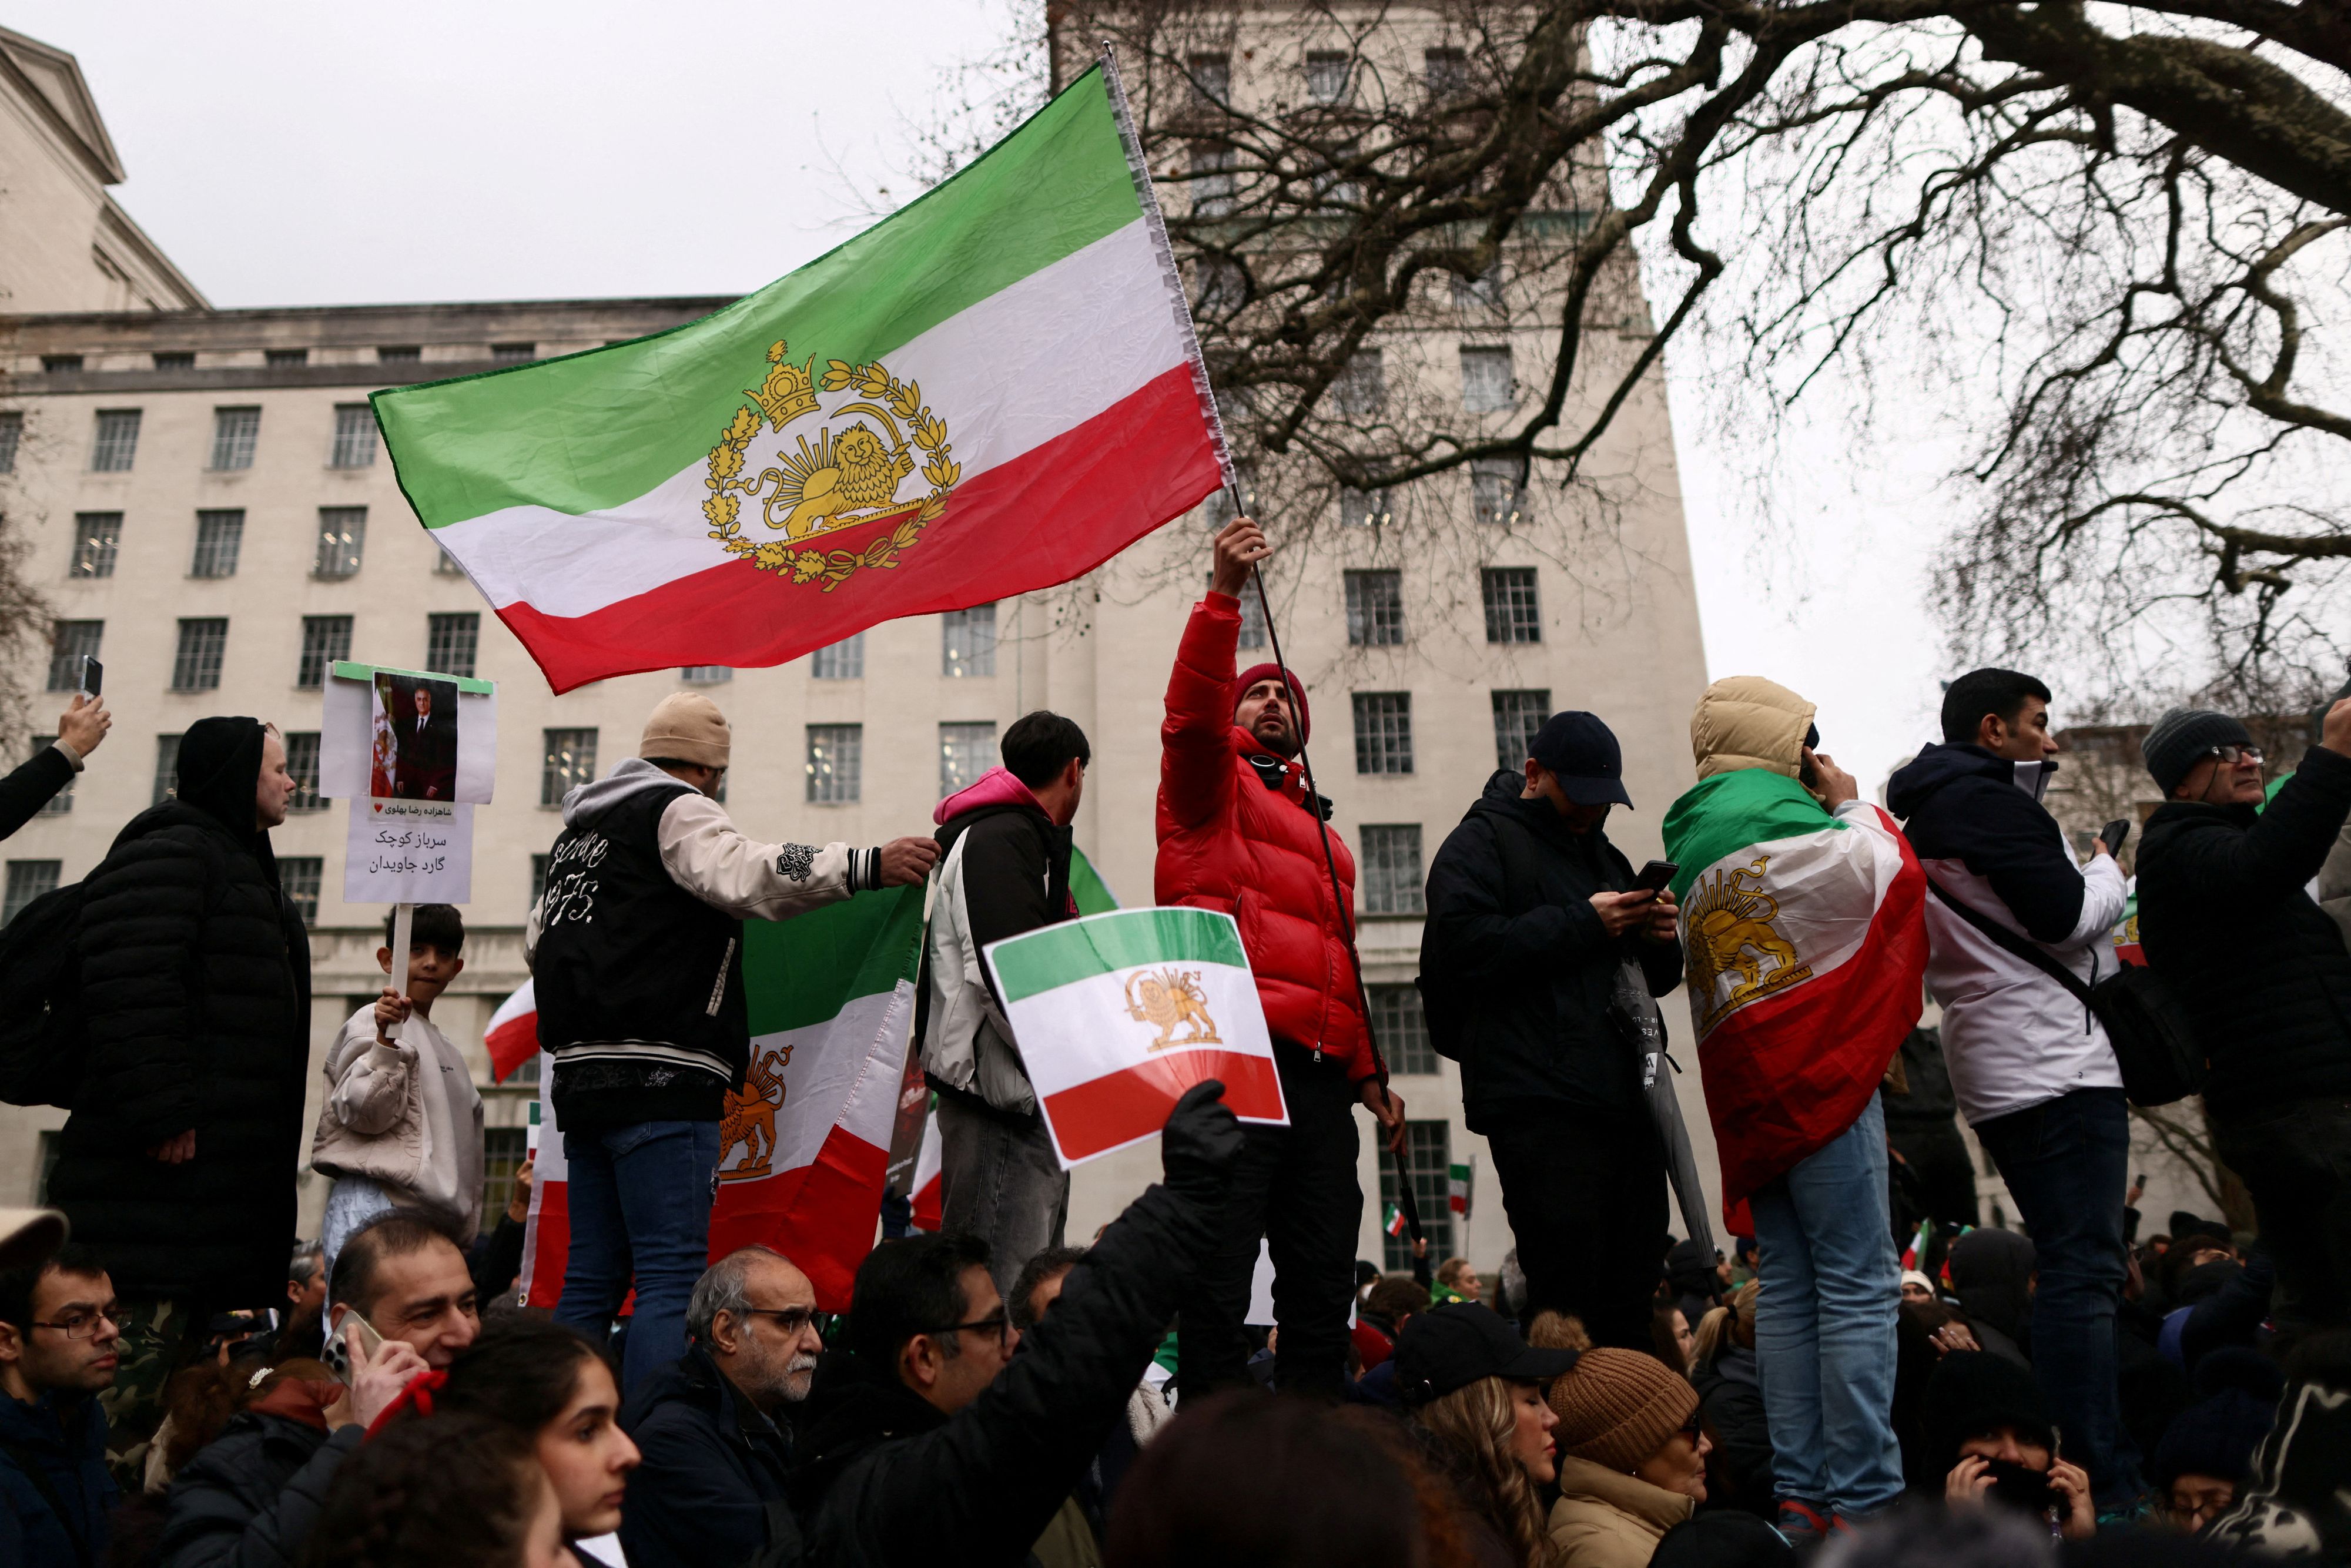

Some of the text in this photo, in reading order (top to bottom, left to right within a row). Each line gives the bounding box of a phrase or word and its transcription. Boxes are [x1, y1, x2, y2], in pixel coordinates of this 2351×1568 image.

[385, 805, 452, 817] شاهزاده رضا پهلوی
[375, 830, 446, 849] سرباز کوچک
[370, 855, 445, 874] گارد جاویدان
